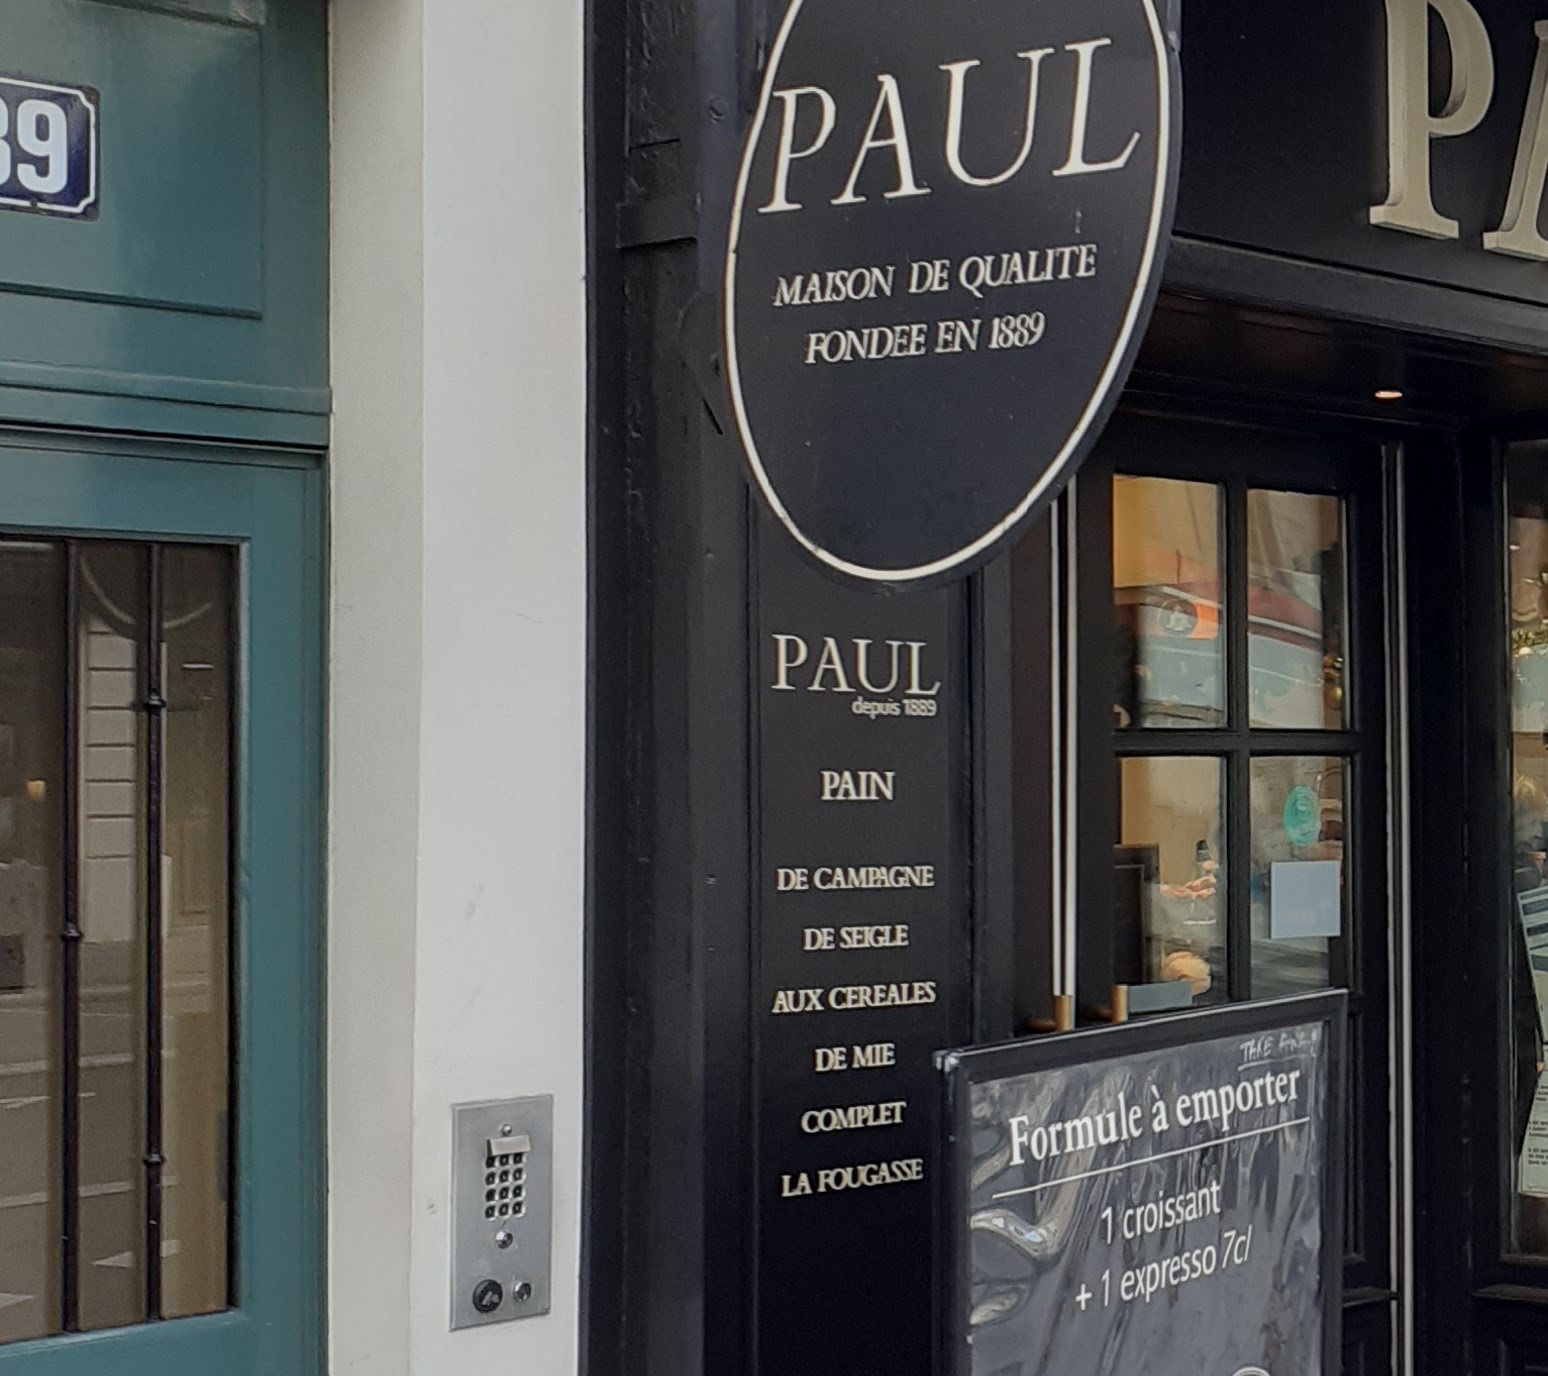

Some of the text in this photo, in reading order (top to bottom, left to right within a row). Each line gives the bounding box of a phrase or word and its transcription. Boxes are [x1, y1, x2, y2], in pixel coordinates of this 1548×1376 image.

[0, 96, 68, 194] 9
[758, 37, 1140, 214] PAUL
[772, 244, 1098, 307] MAISON DE QUALITE
[804, 311, 1046, 364] FONDEE EN 1889
[771, 633, 941, 696] PAUL
[852, 695, 937, 720] depuis 1889
[820, 770, 895, 801] PAIN
[777, 865, 935, 891] DE CAMPAGNE
[803, 924, 910, 951] DE SEIGLE
[772, 981, 937, 1014] AUX CEREALES
[815, 1043, 896, 1072] DE MIE
[1239, 1035, 1274, 1063] TAKE
[801, 1101, 907, 1134] COMPLET
[1008, 1068, 1301, 1167] Formule à emporter
[781, 1158, 924, 1198] LA FOUGASSE
[1101, 1181, 1222, 1245] 1 croissant
[1101, 1269, 1111, 1307] 1
[1120, 1240, 1216, 1303] expresso
[1221, 1224, 1253, 1268] 7cl
